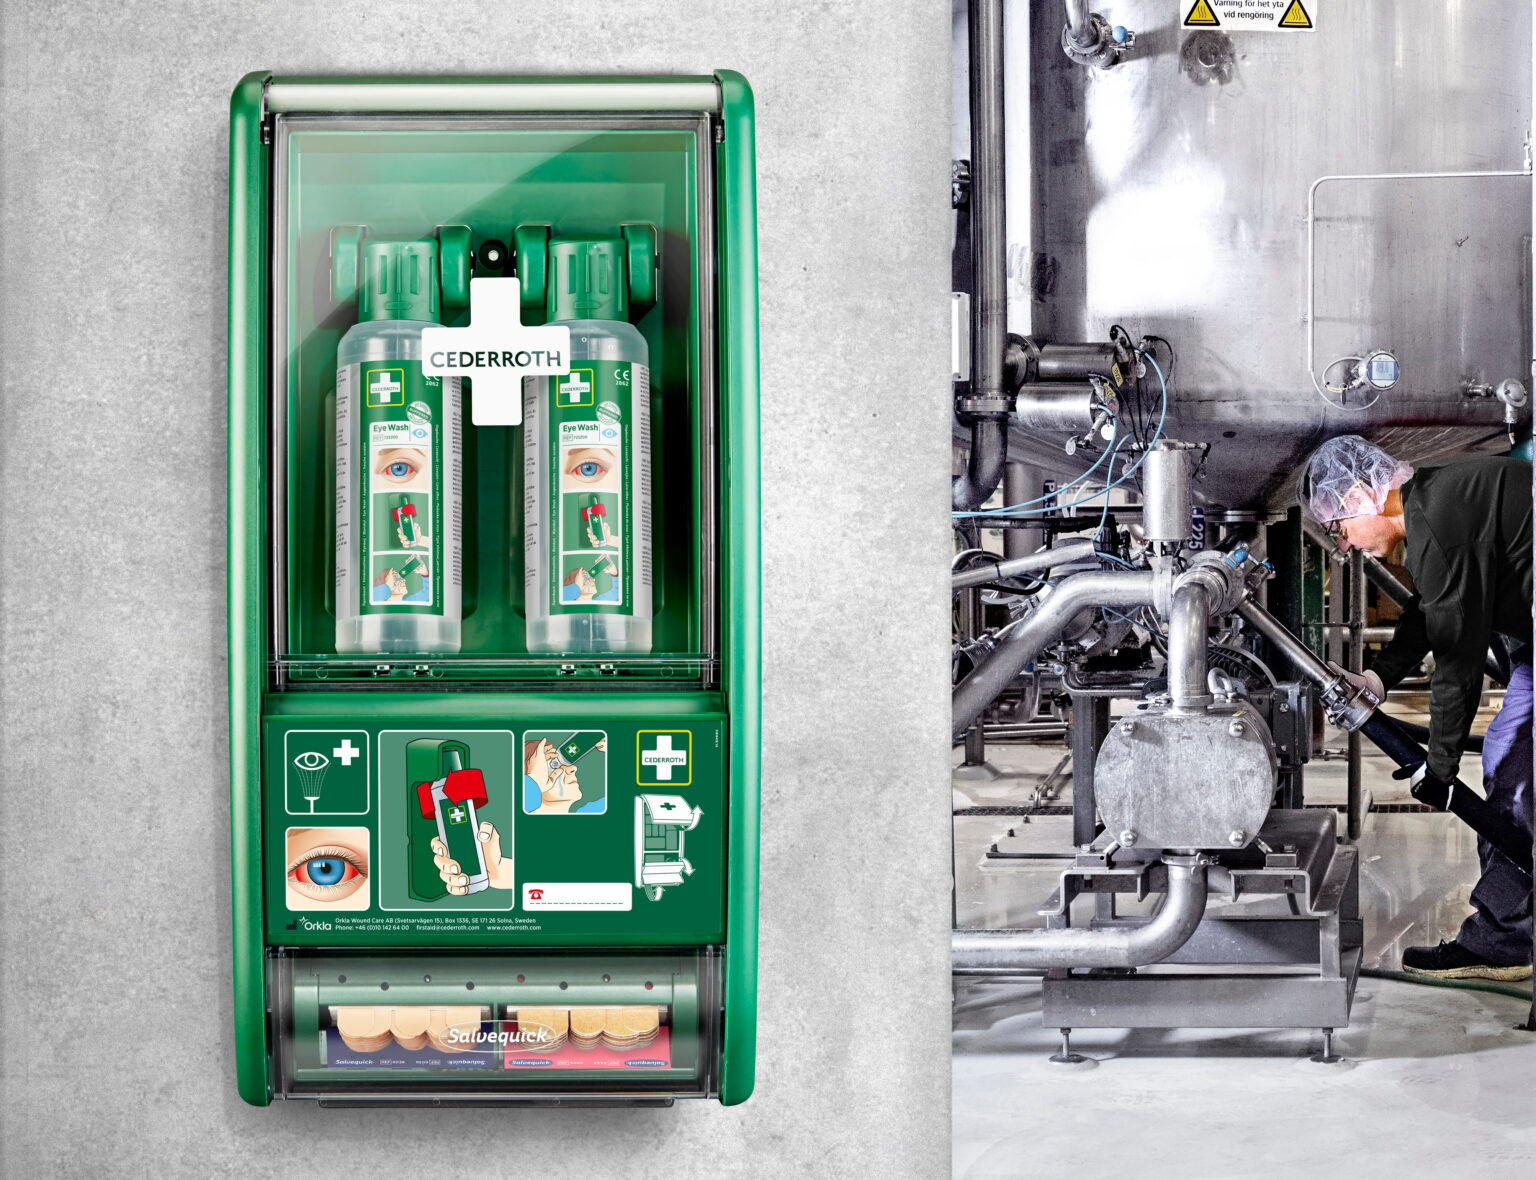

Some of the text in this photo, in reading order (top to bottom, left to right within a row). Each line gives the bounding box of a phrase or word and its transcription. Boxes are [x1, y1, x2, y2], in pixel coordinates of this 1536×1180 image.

[1238, 11, 1274, 20] rengöring
[430, 350, 562, 368] CEDERROTH
[304, 921, 332, 930] Orkla
[447, 1026, 548, 1047] Salvequick
